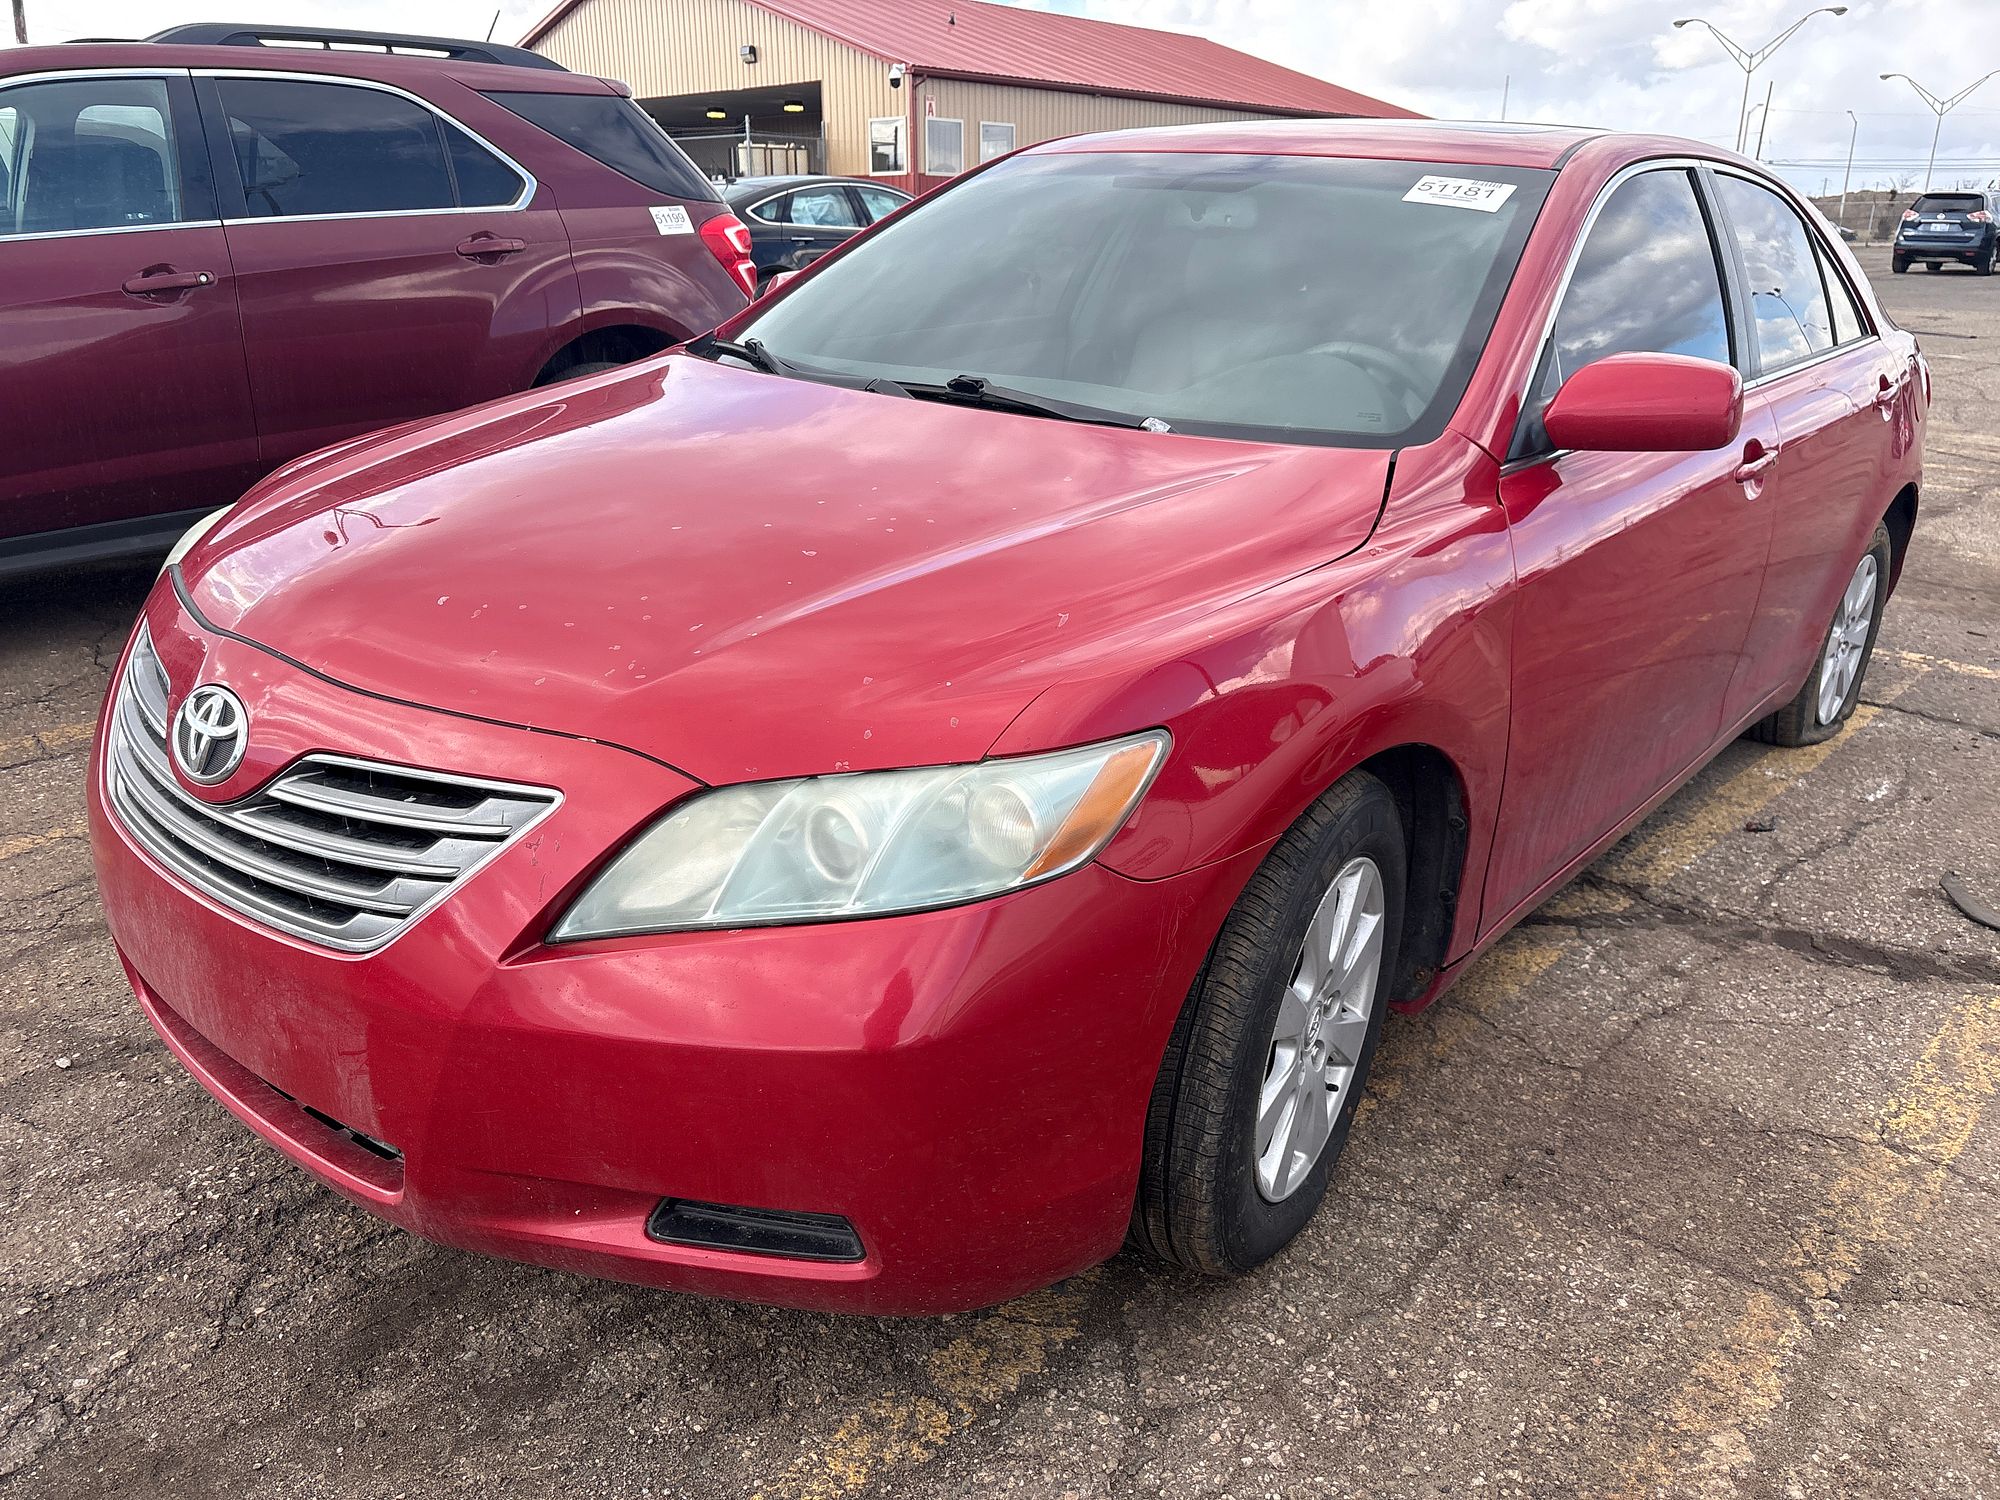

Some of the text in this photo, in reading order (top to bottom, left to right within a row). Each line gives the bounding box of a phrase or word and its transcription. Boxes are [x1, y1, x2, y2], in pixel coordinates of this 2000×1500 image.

[927, 102, 934, 116] A
[1417, 181, 1495, 199] 51181
[655, 212, 686, 224] 51199
